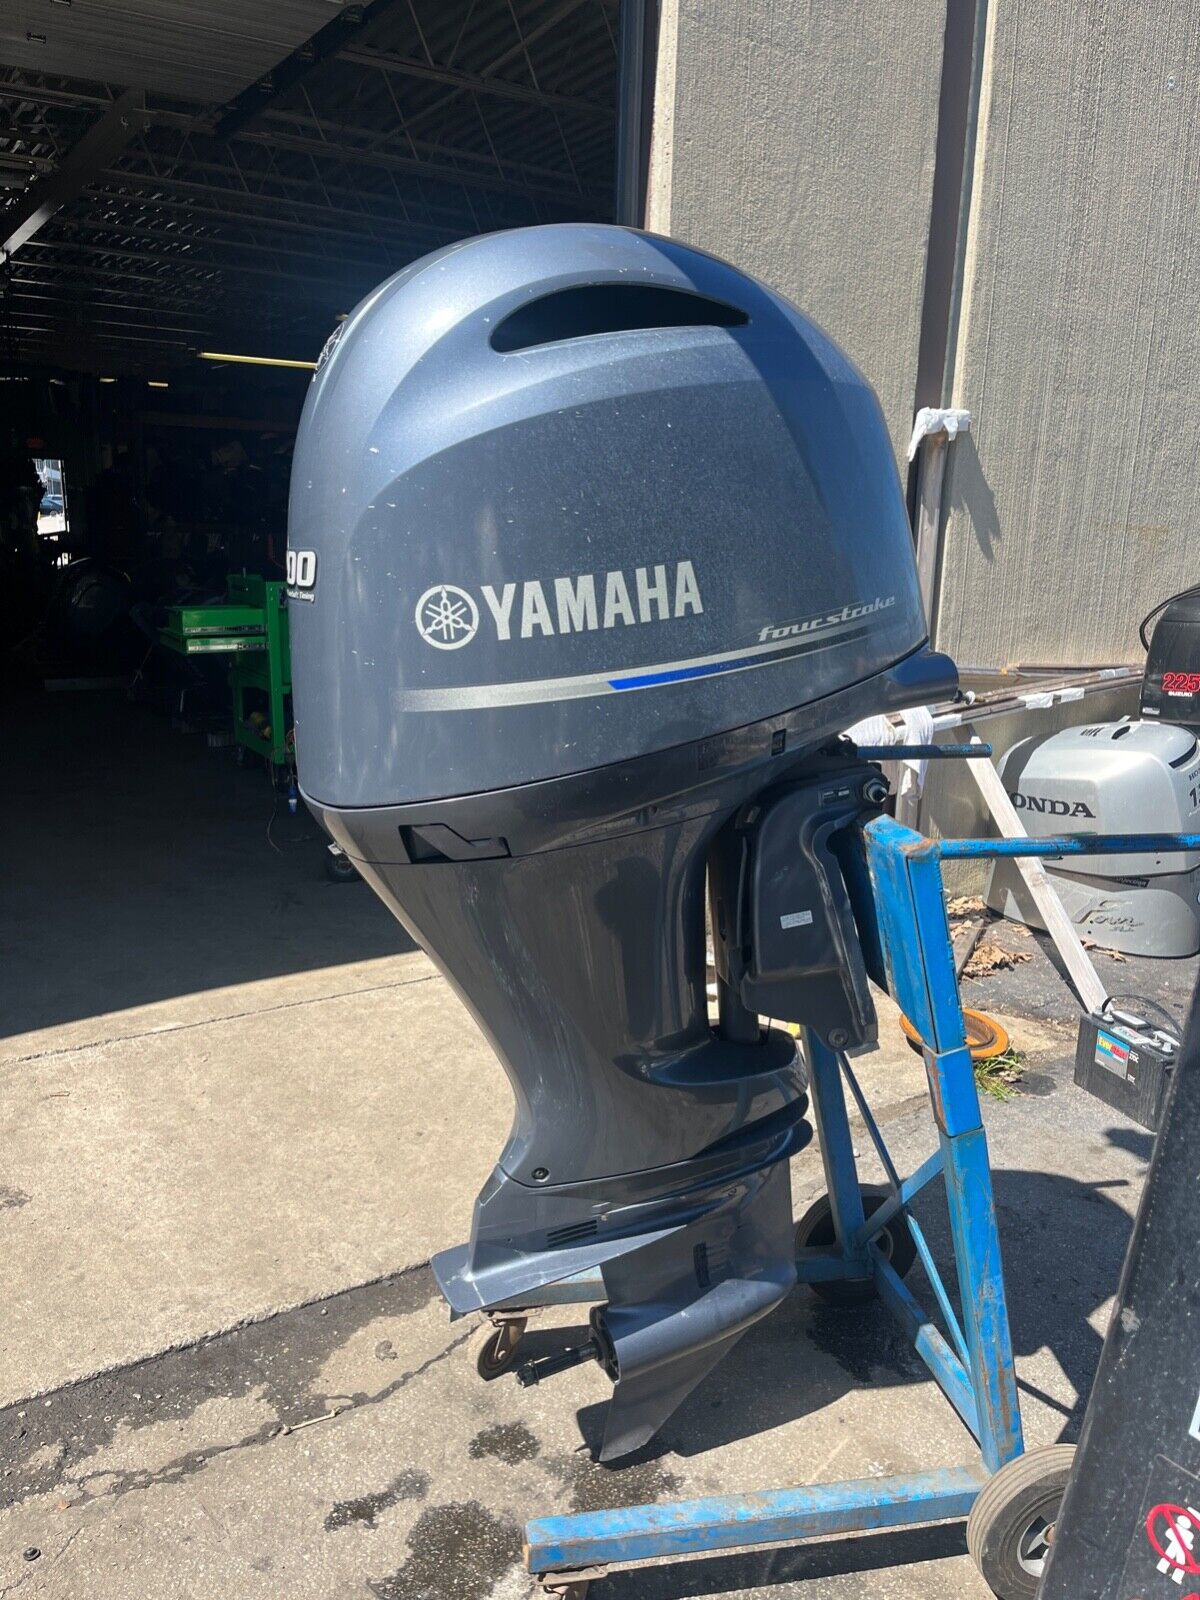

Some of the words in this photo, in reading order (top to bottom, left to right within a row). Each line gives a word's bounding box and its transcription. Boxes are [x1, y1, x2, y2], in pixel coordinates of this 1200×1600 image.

[481, 561, 704, 641] YAMAHA
[1162, 671, 1200, 693] 225
[1007, 791, 1097, 819] ONDA
